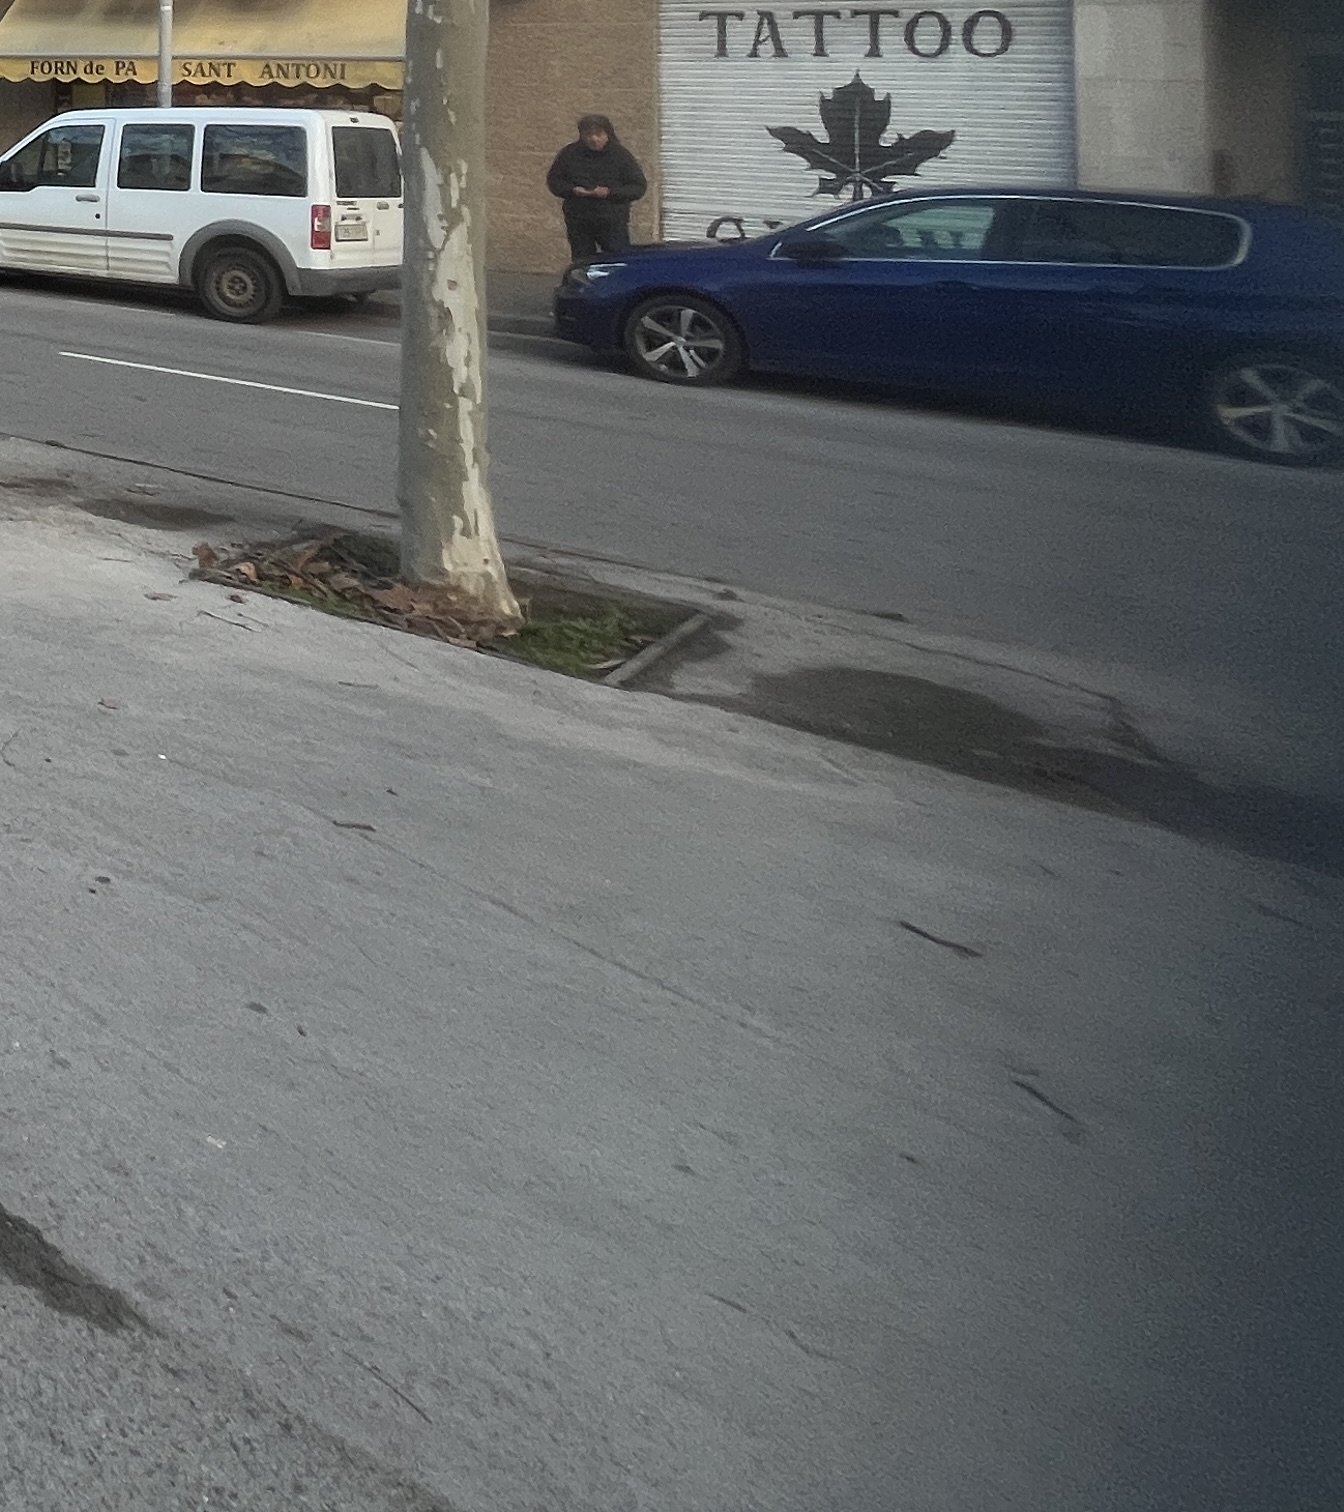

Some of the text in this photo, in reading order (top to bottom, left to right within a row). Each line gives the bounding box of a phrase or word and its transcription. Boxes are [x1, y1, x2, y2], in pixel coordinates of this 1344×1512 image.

[698, 9, 1014, 58] TATTOO
[30, 60, 138, 76] FORN de PA
[181, 61, 347, 80] SANT ANTONI
